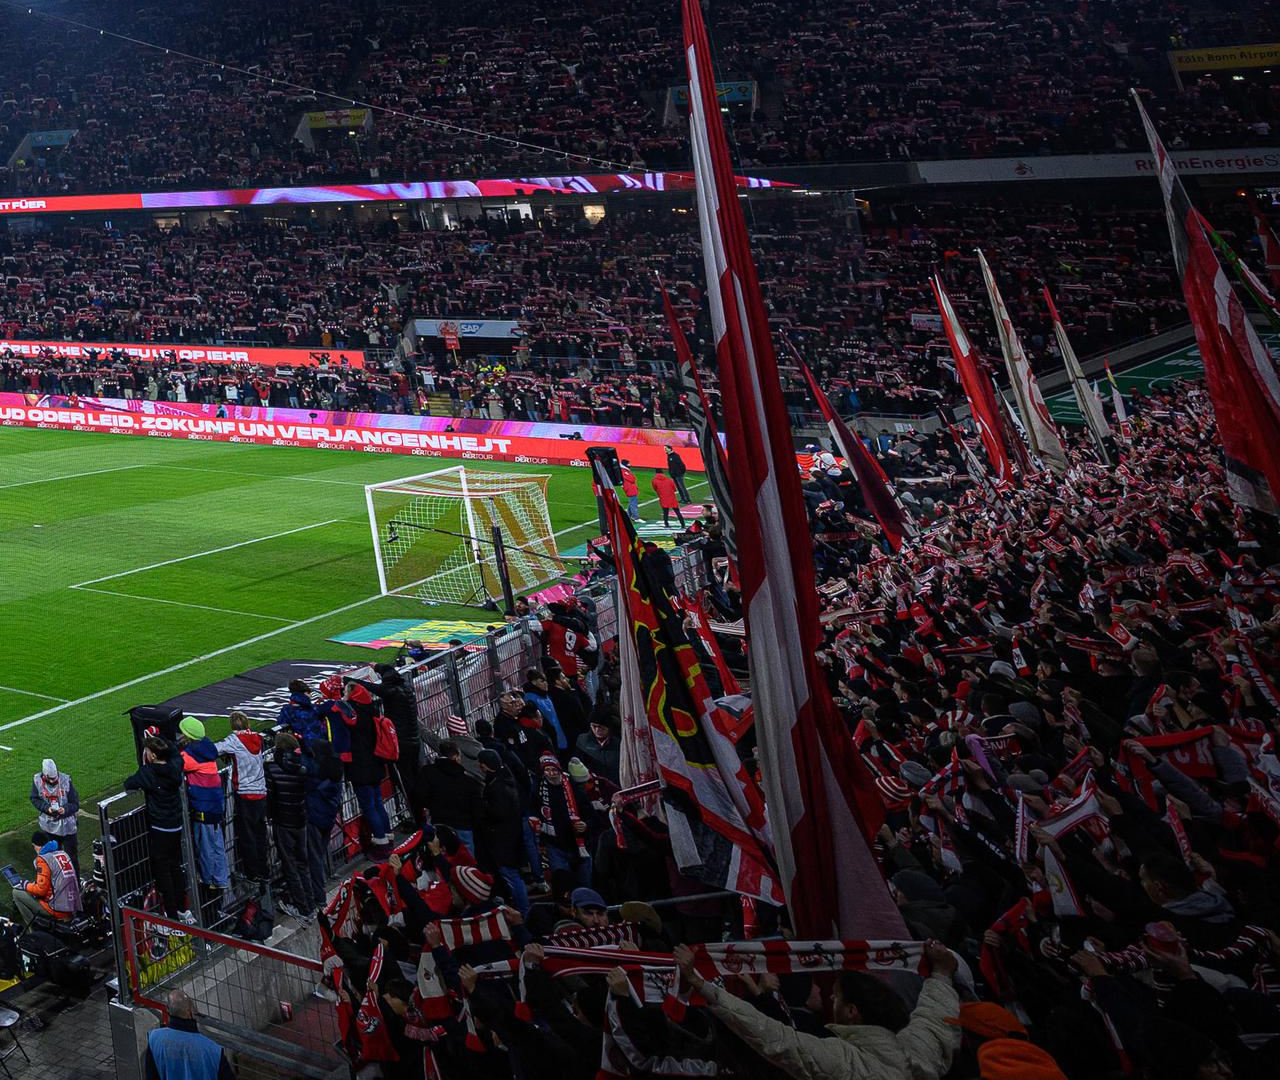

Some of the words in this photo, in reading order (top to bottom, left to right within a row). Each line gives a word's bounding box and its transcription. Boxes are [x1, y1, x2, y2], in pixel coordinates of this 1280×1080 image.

[1207, 53, 1237, 61] Bonn
[1240, 50, 1280, 61] Airpor
[11, 199, 47, 210] FÜER
[461, 324, 480, 332] SAP
[58, 345, 81, 356] HE
[179, 350, 206, 360] OP
[206, 351, 249, 362] IEHR
[27, 408, 86, 425] ODER
[86, 412, 140, 429] LEID,
[140, 416, 236, 434] ZOKUNF
[237, 422, 276, 438] UN
[317, 439, 345, 451] DERTOUR
[363, 443, 392, 454] DERTOUR
[411, 447, 442, 458] DERTOUR
[461, 450, 494, 461] DERTOUR
[515, 455, 548, 465] DERTOUR
[570, 458, 592, 468] DERT
